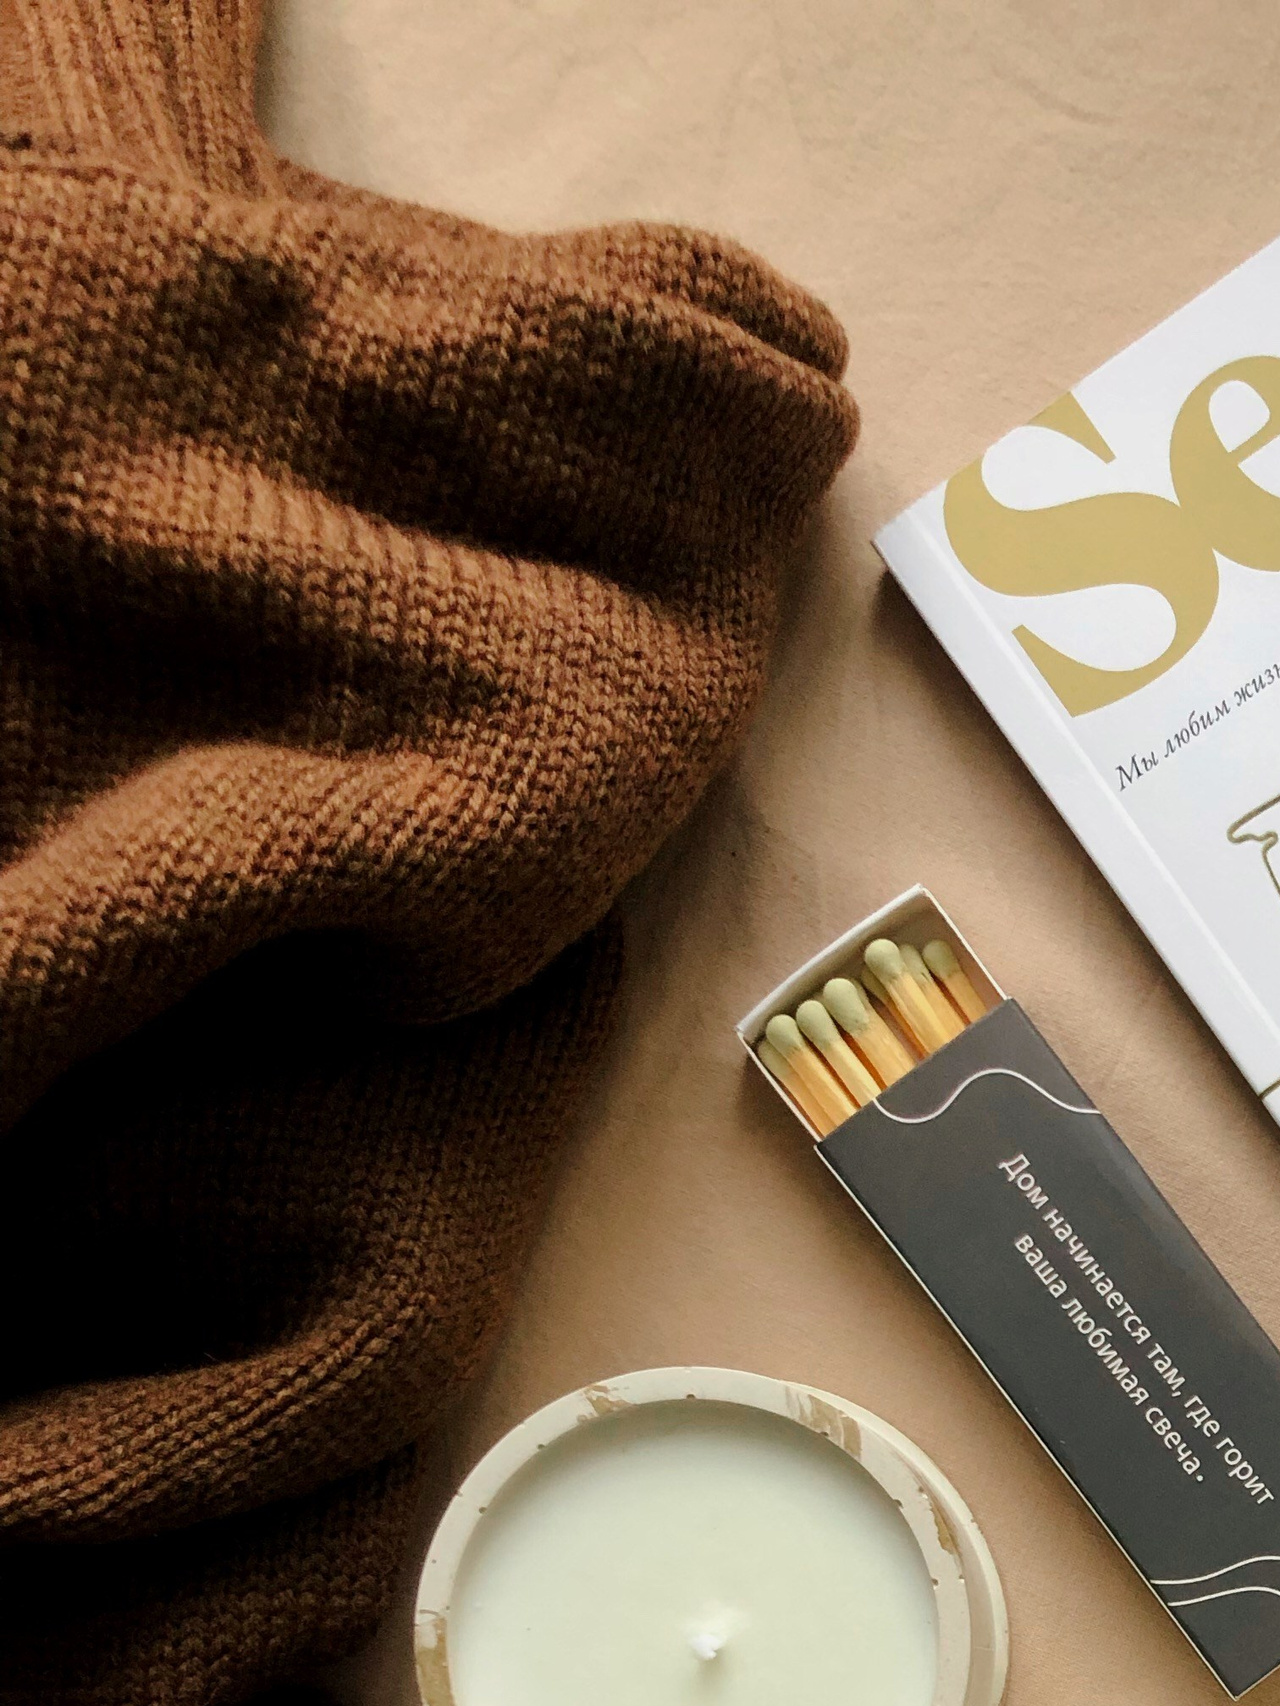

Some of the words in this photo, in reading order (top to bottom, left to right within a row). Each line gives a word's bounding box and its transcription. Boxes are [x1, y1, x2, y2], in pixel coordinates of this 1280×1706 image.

[1115, 750, 1160, 791] Мы
[1163, 699, 1231, 759] любим
[999, 1153, 1049, 1210] Дом
[1043, 1207, 1152, 1346] начинается
[1147, 1343, 1187, 1397] там,
[1184, 1394, 1221, 1438] где
[1216, 1437, 1275, 1506] горит
[1014, 1233, 1068, 1299] ваша
[1061, 1297, 1150, 1406] любимая
[1144, 1406, 1204, 1482] свеча.
